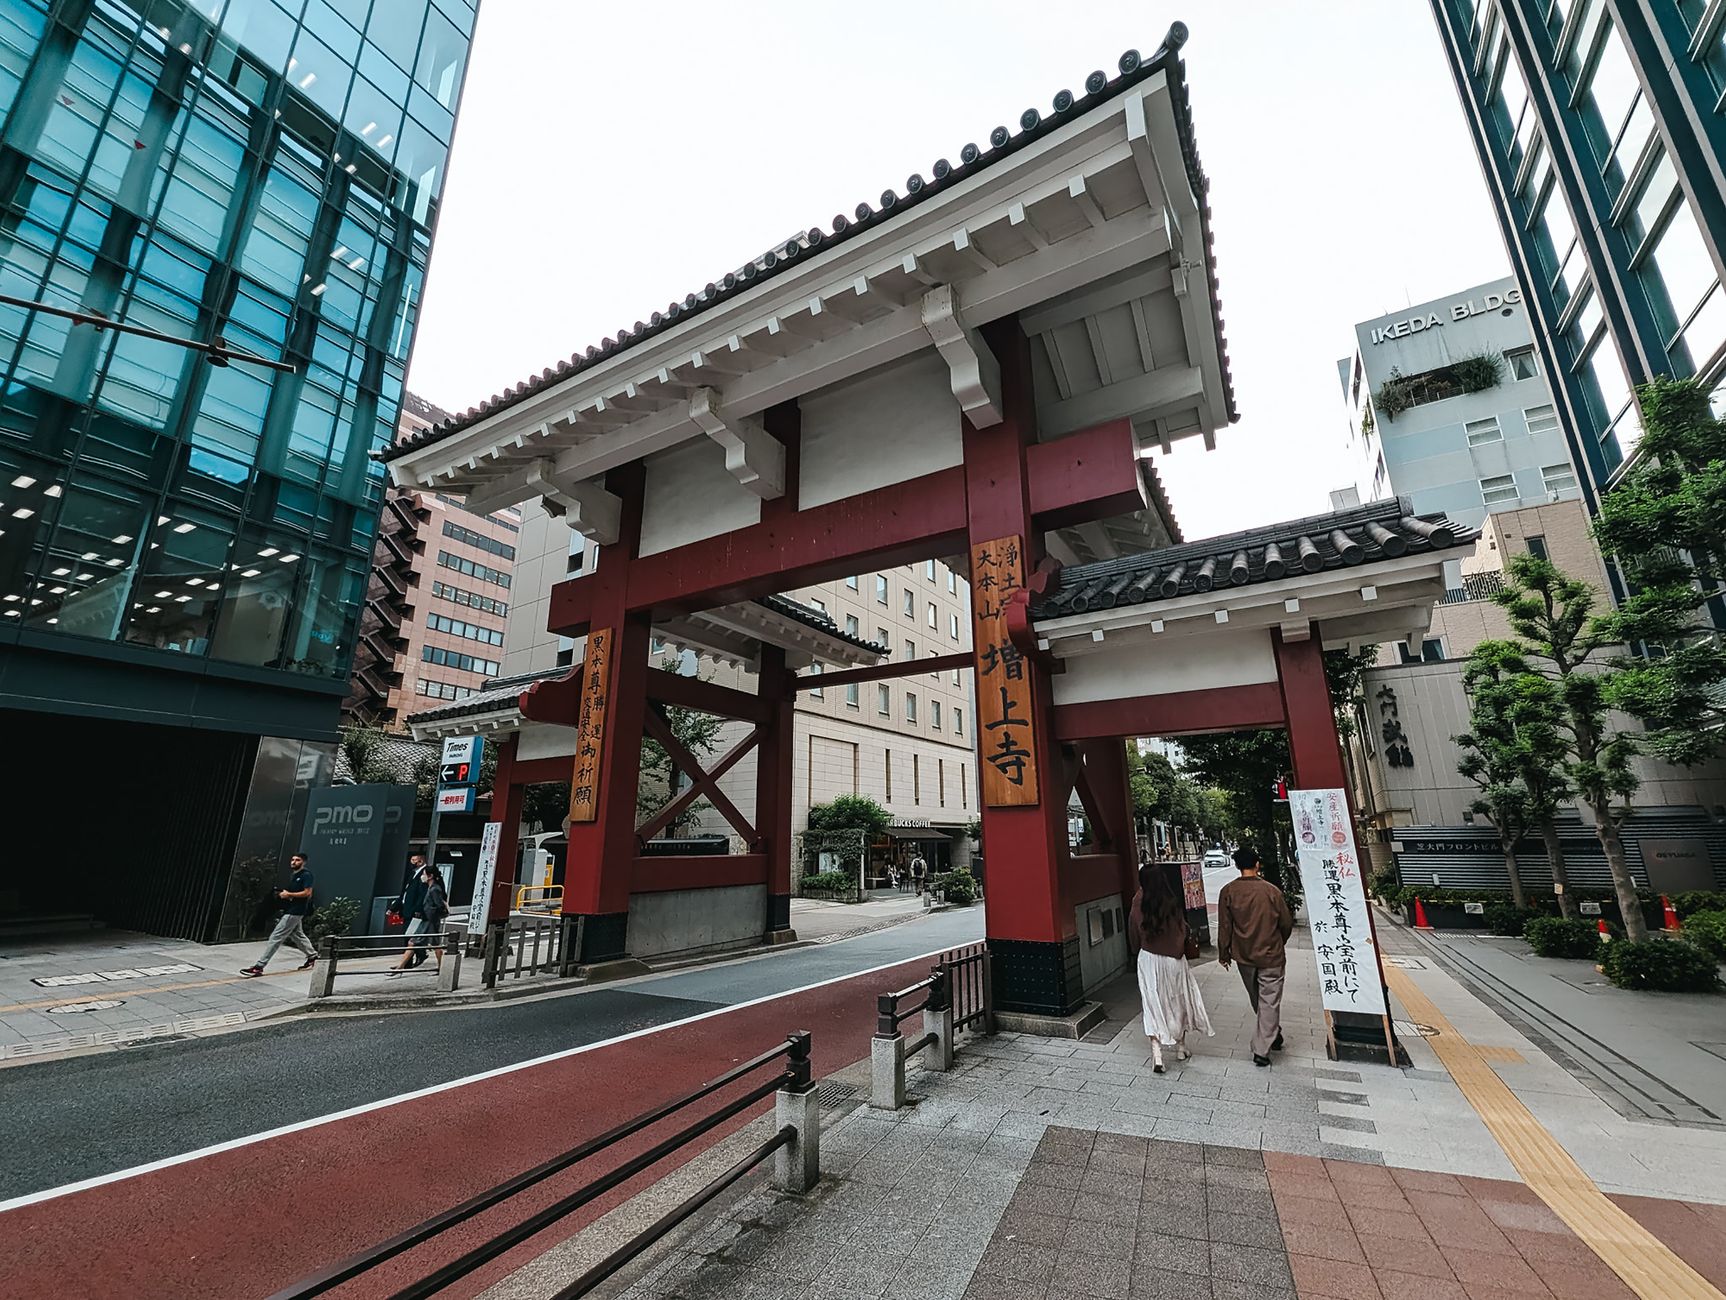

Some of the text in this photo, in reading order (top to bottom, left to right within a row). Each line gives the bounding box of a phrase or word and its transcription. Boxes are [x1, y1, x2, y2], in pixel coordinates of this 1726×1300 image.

[1370, 289, 1521, 344] IKEDA BLDG
[976, 549, 1000, 621] 大本山
[447, 742, 469, 752] Times
[458, 764, 468, 781] P
[312, 805, 373, 835] pmo
[912, 820, 931, 828] COFFEE
[1336, 852, 1356, 879] 秘仏
[1317, 943, 1343, 995] 安国殿
